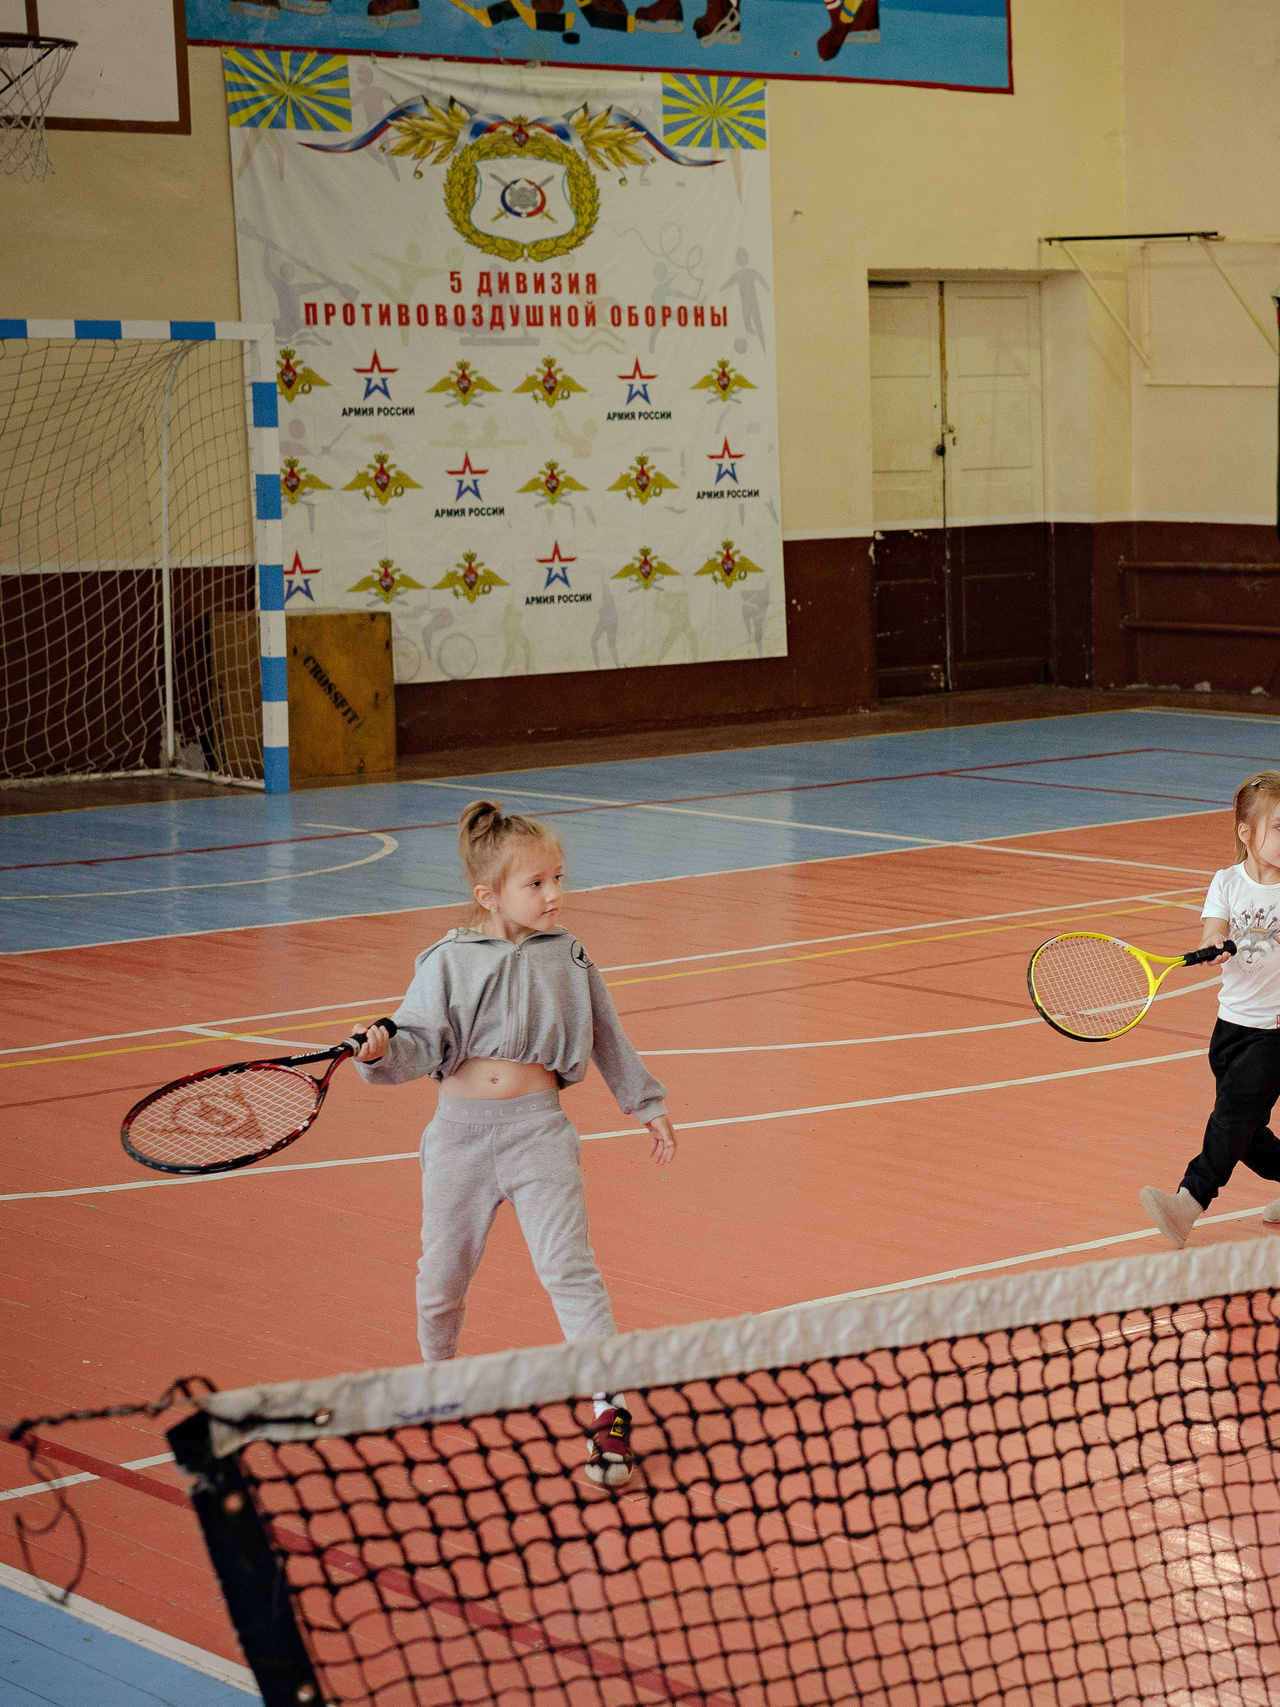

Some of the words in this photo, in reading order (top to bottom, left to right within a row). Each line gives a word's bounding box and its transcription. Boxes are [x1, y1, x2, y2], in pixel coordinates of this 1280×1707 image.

[450, 271, 462, 293] 5
[477, 271, 597, 297] ДИВИЗИЯ
[304, 300, 596, 331] ПРОТИВОВОЗДУШНОЙ
[610, 305, 728, 327] ОБОРОНЫ
[341, 407, 374, 416] АРМИЯ
[377, 407, 415, 416] РОССИИ
[606, 411, 636, 420] АРМИЯ
[638, 411, 672, 420] РОССИИ
[696, 490, 725, 499] АРМИЯ
[726, 489, 760, 498] РОССИИ
[434, 507, 466, 518] АРМИЯ
[468, 507, 505, 516] РОССИИ
[525, 594, 555, 605] АРМИЯ
[557, 593, 592, 604] РОССИИ
